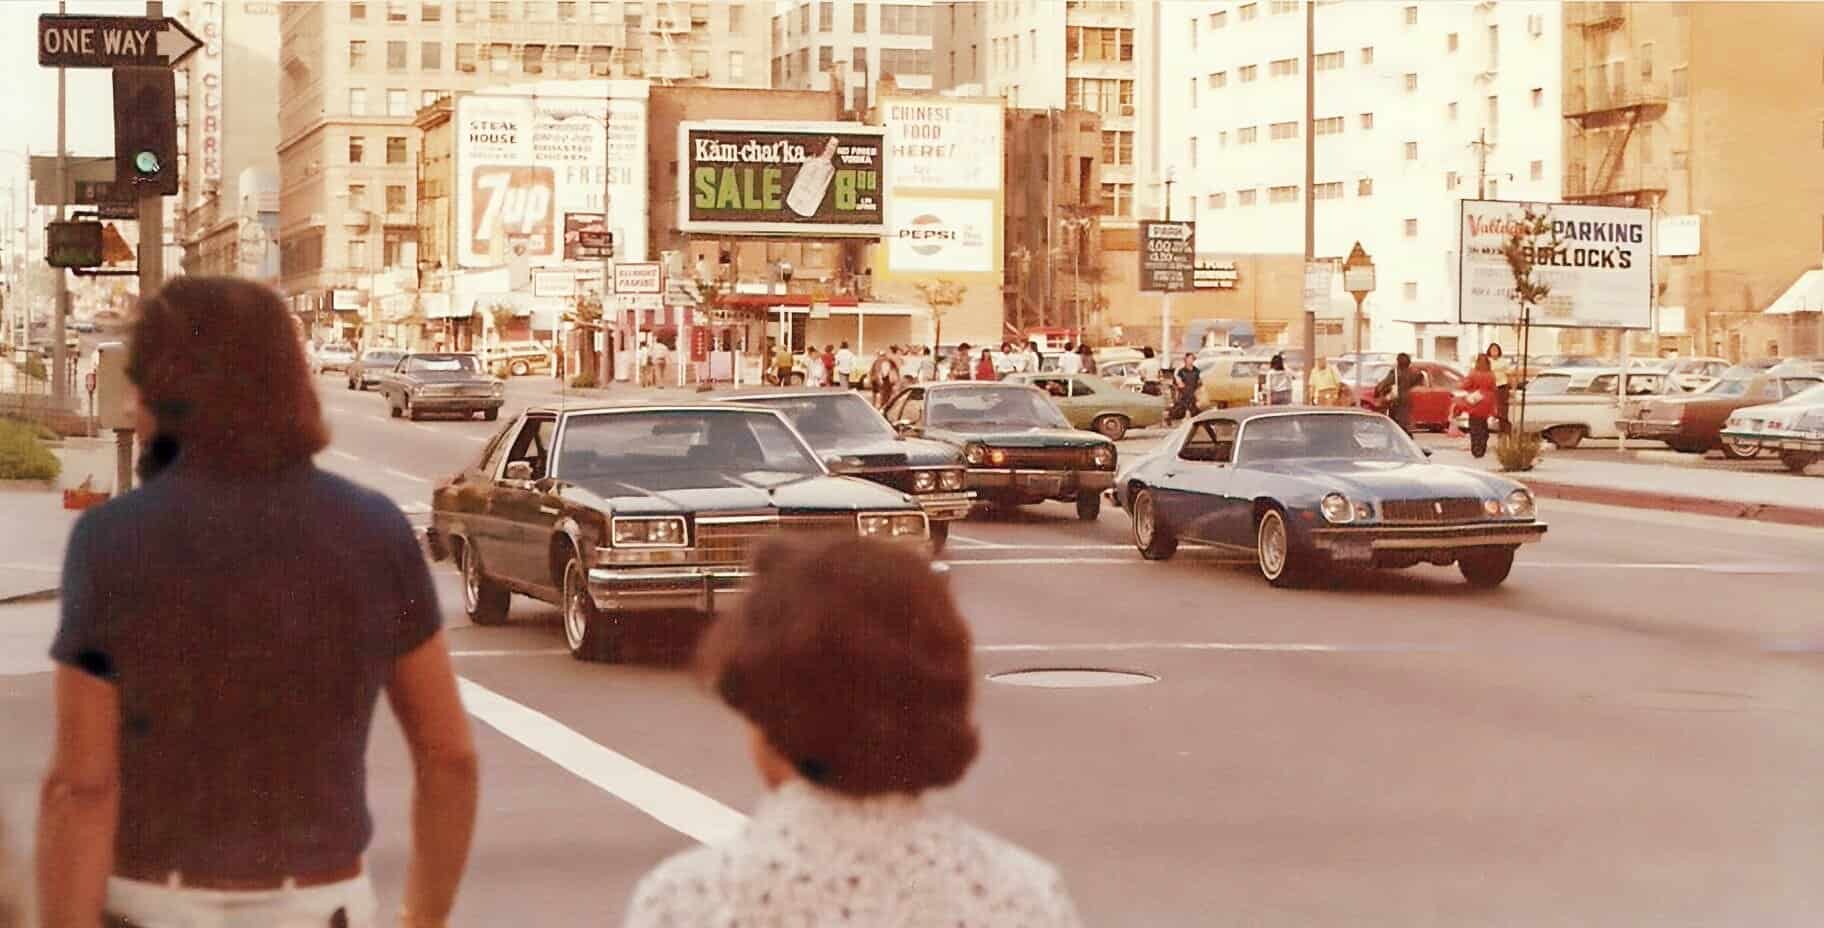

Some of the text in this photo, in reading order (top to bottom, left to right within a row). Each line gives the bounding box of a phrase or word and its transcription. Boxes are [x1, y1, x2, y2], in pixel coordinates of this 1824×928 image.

[43, 28, 150, 55] ONE WAY
[891, 106, 953, 121] CHINESE
[202, 73, 218, 175] CLARK
[470, 121, 518, 131] STEAK
[903, 124, 941, 139] FOOD
[469, 134, 518, 144] HOUSE
[566, 166, 632, 184] FRESH
[694, 167, 782, 210] SALE
[899, 230, 956, 240] PEPSI
[1551, 220, 1643, 243] PARKING
[1522, 246, 1632, 268] BULLOCK'S
